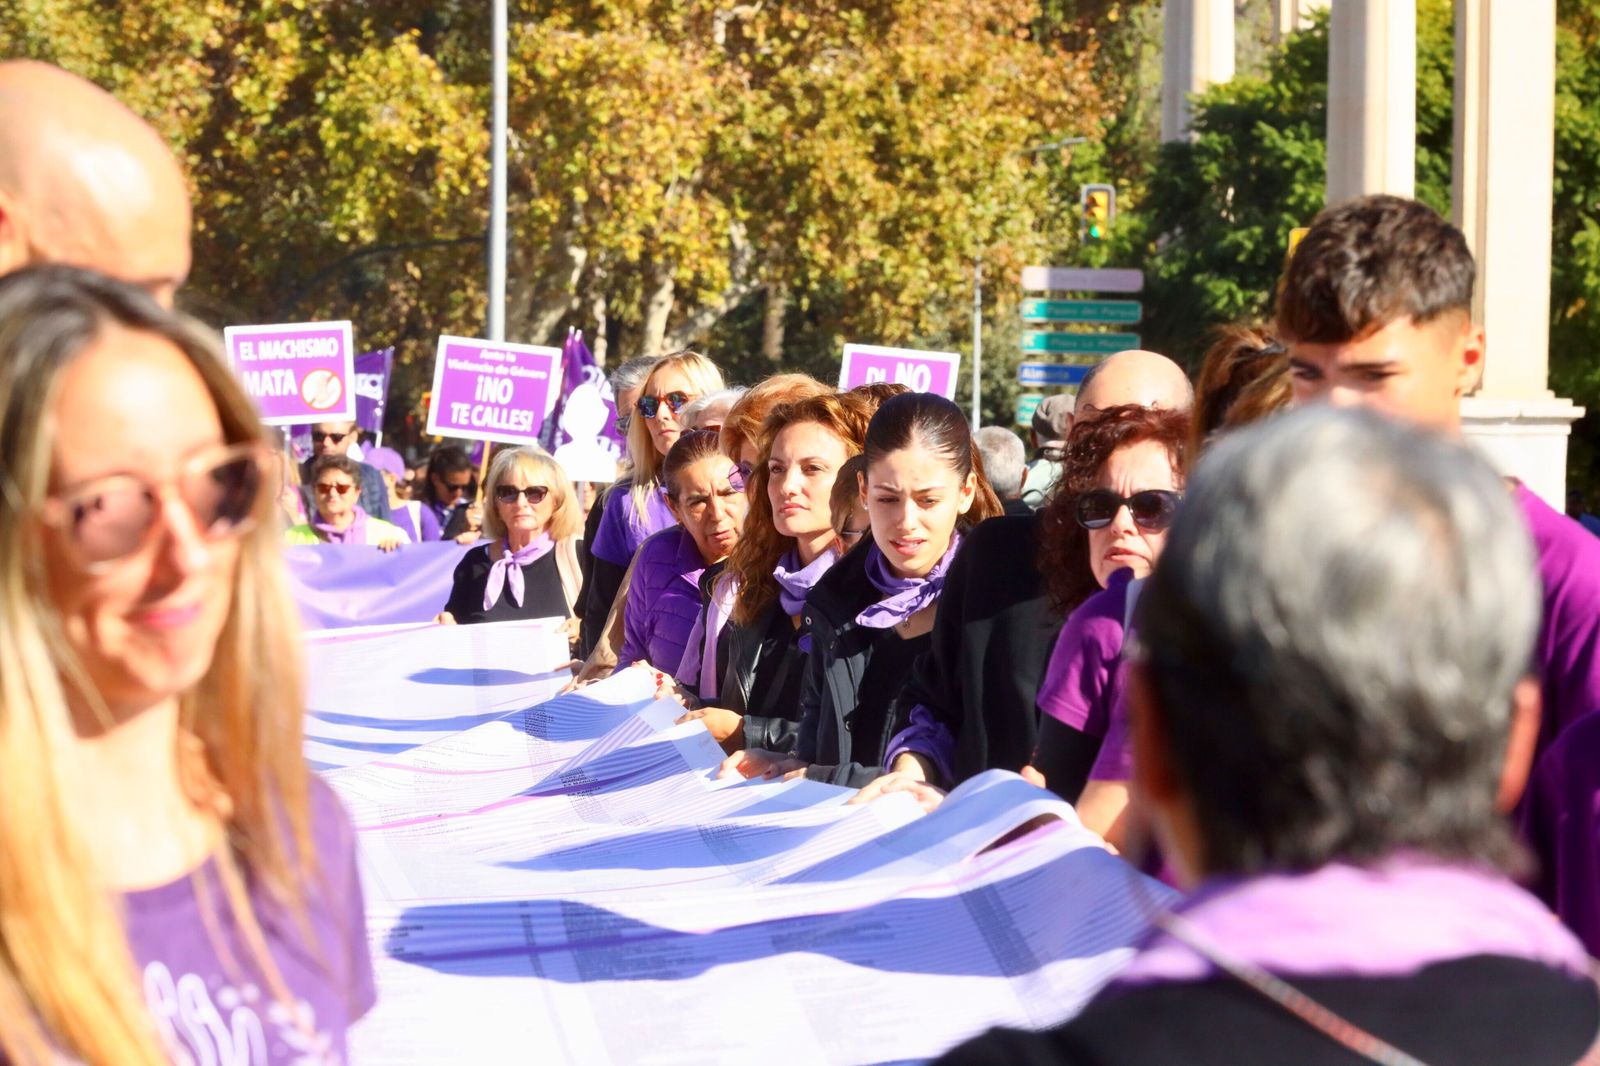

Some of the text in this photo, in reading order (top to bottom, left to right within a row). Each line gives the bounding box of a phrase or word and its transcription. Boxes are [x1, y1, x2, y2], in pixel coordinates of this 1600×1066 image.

[239, 336, 339, 361] EL MACHISMO
[447, 358, 494, 373] Violencia
[494, 364, 510, 375] de
[895, 361, 932, 393] NO
[243, 368, 298, 397] MATA
[474, 374, 514, 405] ¡NO
[450, 401, 535, 433] TE CALLES!
